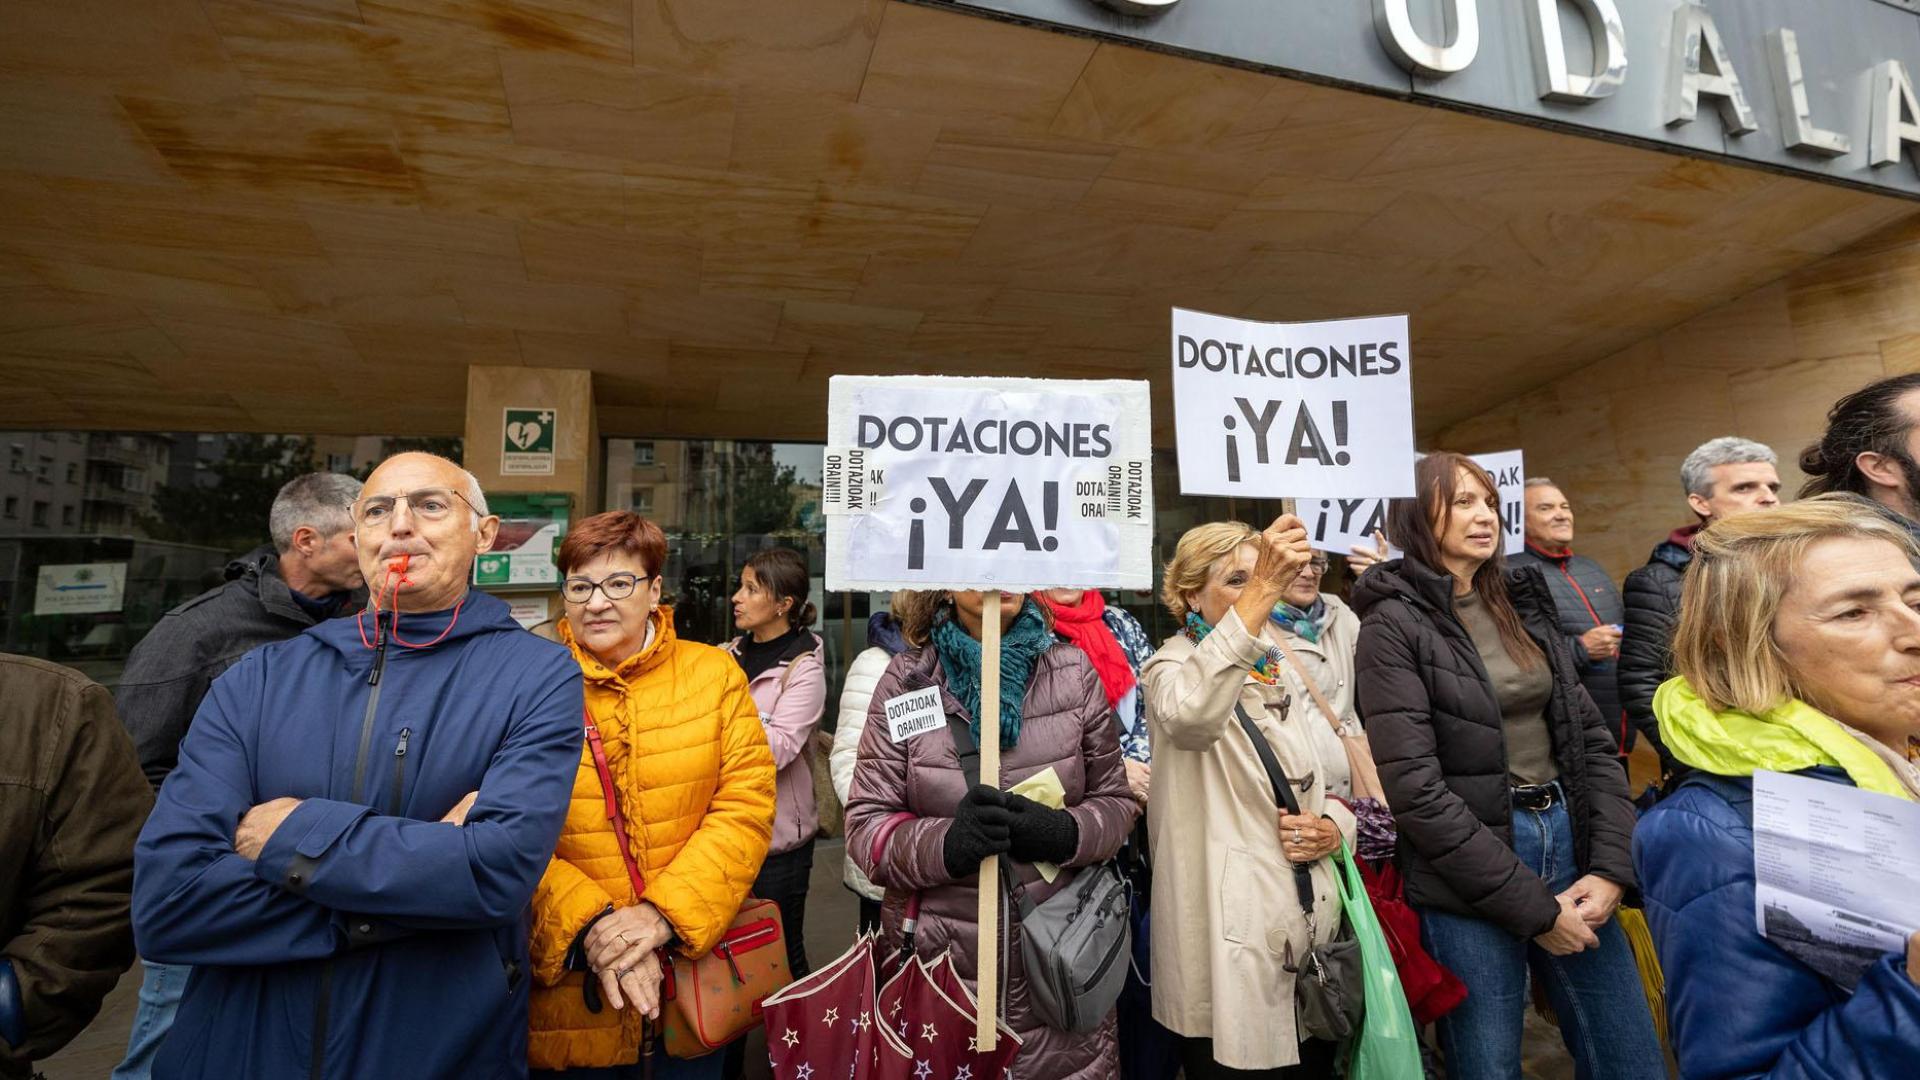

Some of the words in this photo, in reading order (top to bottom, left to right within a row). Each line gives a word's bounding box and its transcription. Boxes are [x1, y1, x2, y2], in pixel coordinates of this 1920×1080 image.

[1178, 335, 1402, 379] DOTACIONES
[858, 415, 1113, 458] DOTACIONES
[1223, 397, 1351, 482] ¡YA!
[826, 455, 841, 503] ORAIN!!!!
[848, 450, 864, 509] DOTAZIOAK
[1076, 481, 1106, 496] DOTA
[1107, 465, 1122, 511] ORAIN!!!!
[1127, 461, 1142, 519] DOTAZIOAK
[908, 477, 1059, 570] ¡YA!
[888, 694, 937, 719] DOTAZIOAK
[897, 714, 937, 737] ORAIN!!!!
